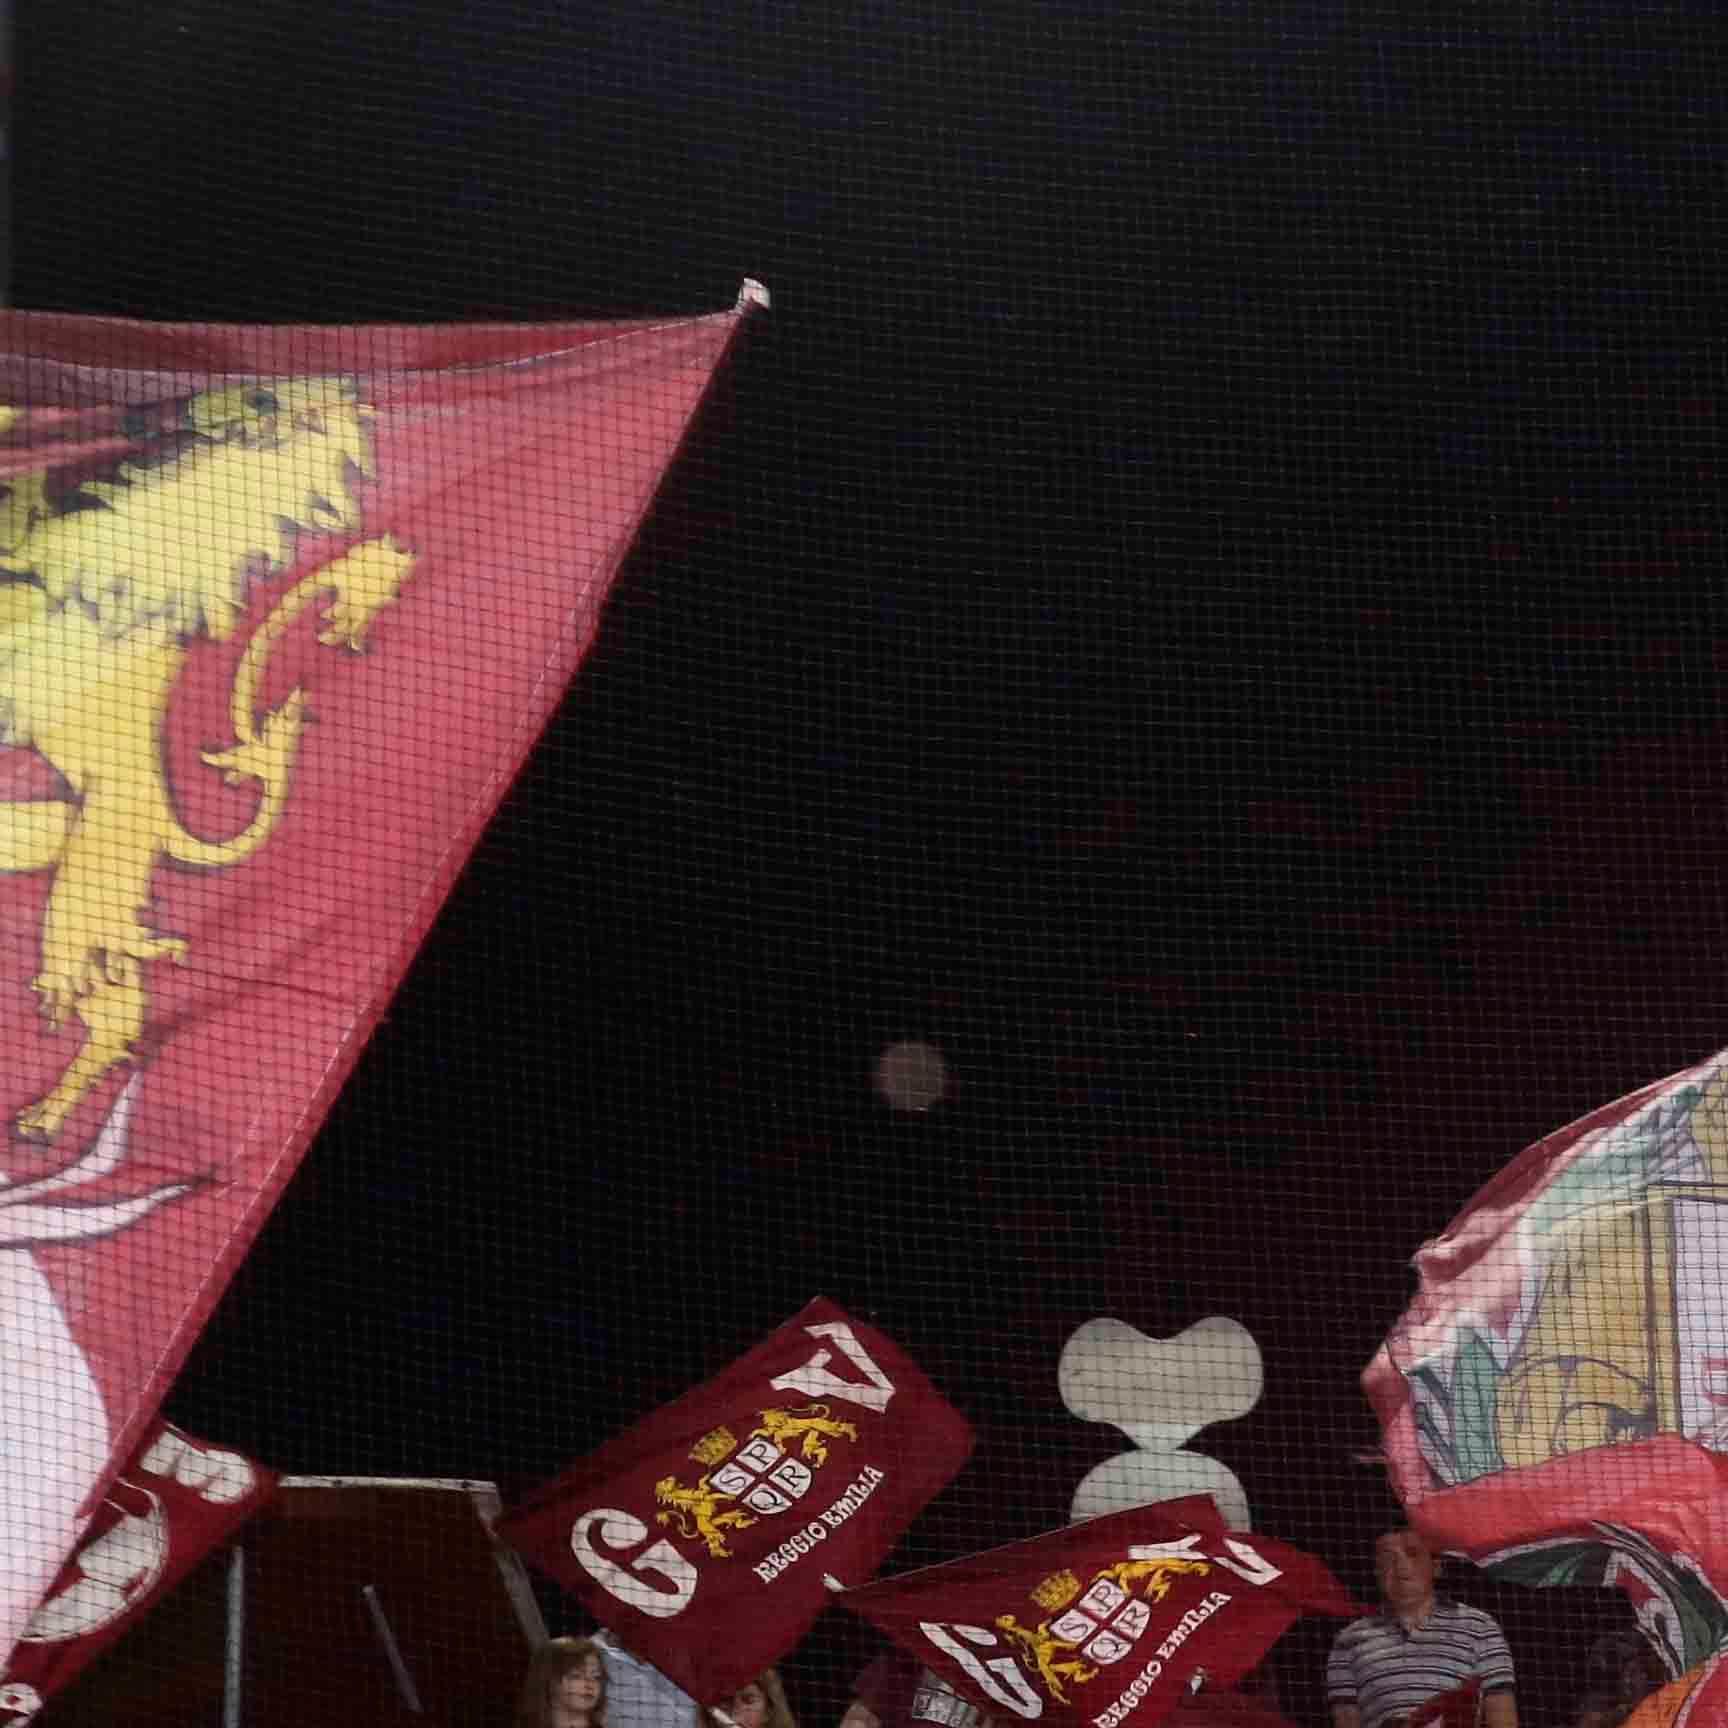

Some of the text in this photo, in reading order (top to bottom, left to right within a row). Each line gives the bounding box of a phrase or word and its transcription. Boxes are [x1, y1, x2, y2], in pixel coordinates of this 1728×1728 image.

[752, 1463, 884, 1584] REGGIO EMILIA
[1156, 1590, 1232, 1666] EMILIA
